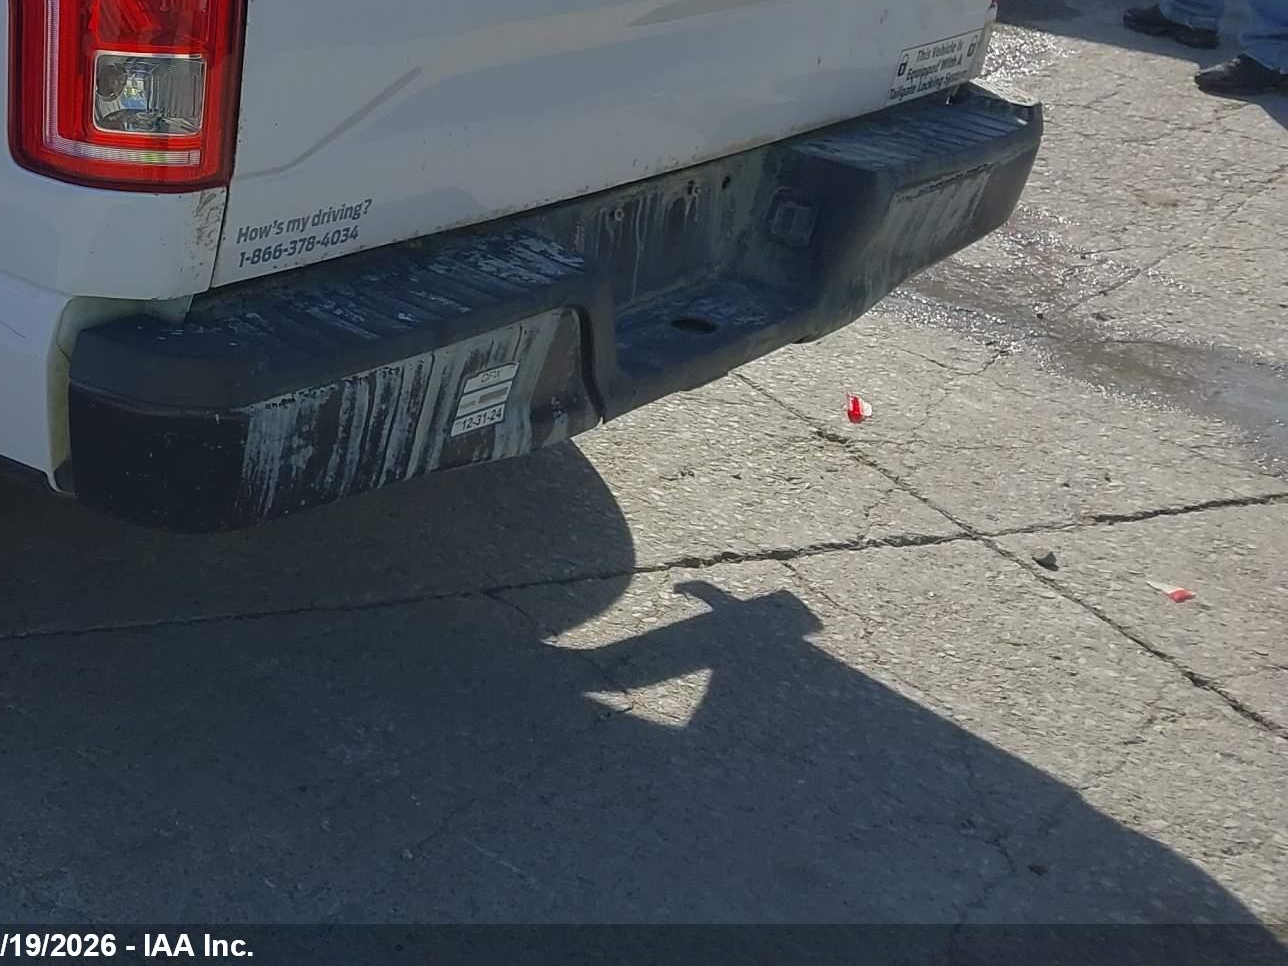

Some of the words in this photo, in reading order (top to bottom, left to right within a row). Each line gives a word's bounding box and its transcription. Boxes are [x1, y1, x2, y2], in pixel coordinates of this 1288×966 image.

[916, 48, 931, 63] This
[932, 41, 957, 58] Vehicle
[906, 62, 940, 82] Equipped
[889, 82, 917, 101] Tailgate
[917, 75, 944, 93] Locking
[236, 220, 284, 244] How's
[286, 216, 311, 234] my
[311, 199, 373, 228] driving?
[239, 225, 359, 268] 1-866-378-4034
[462, 408, 502, 430] 12-31-24
